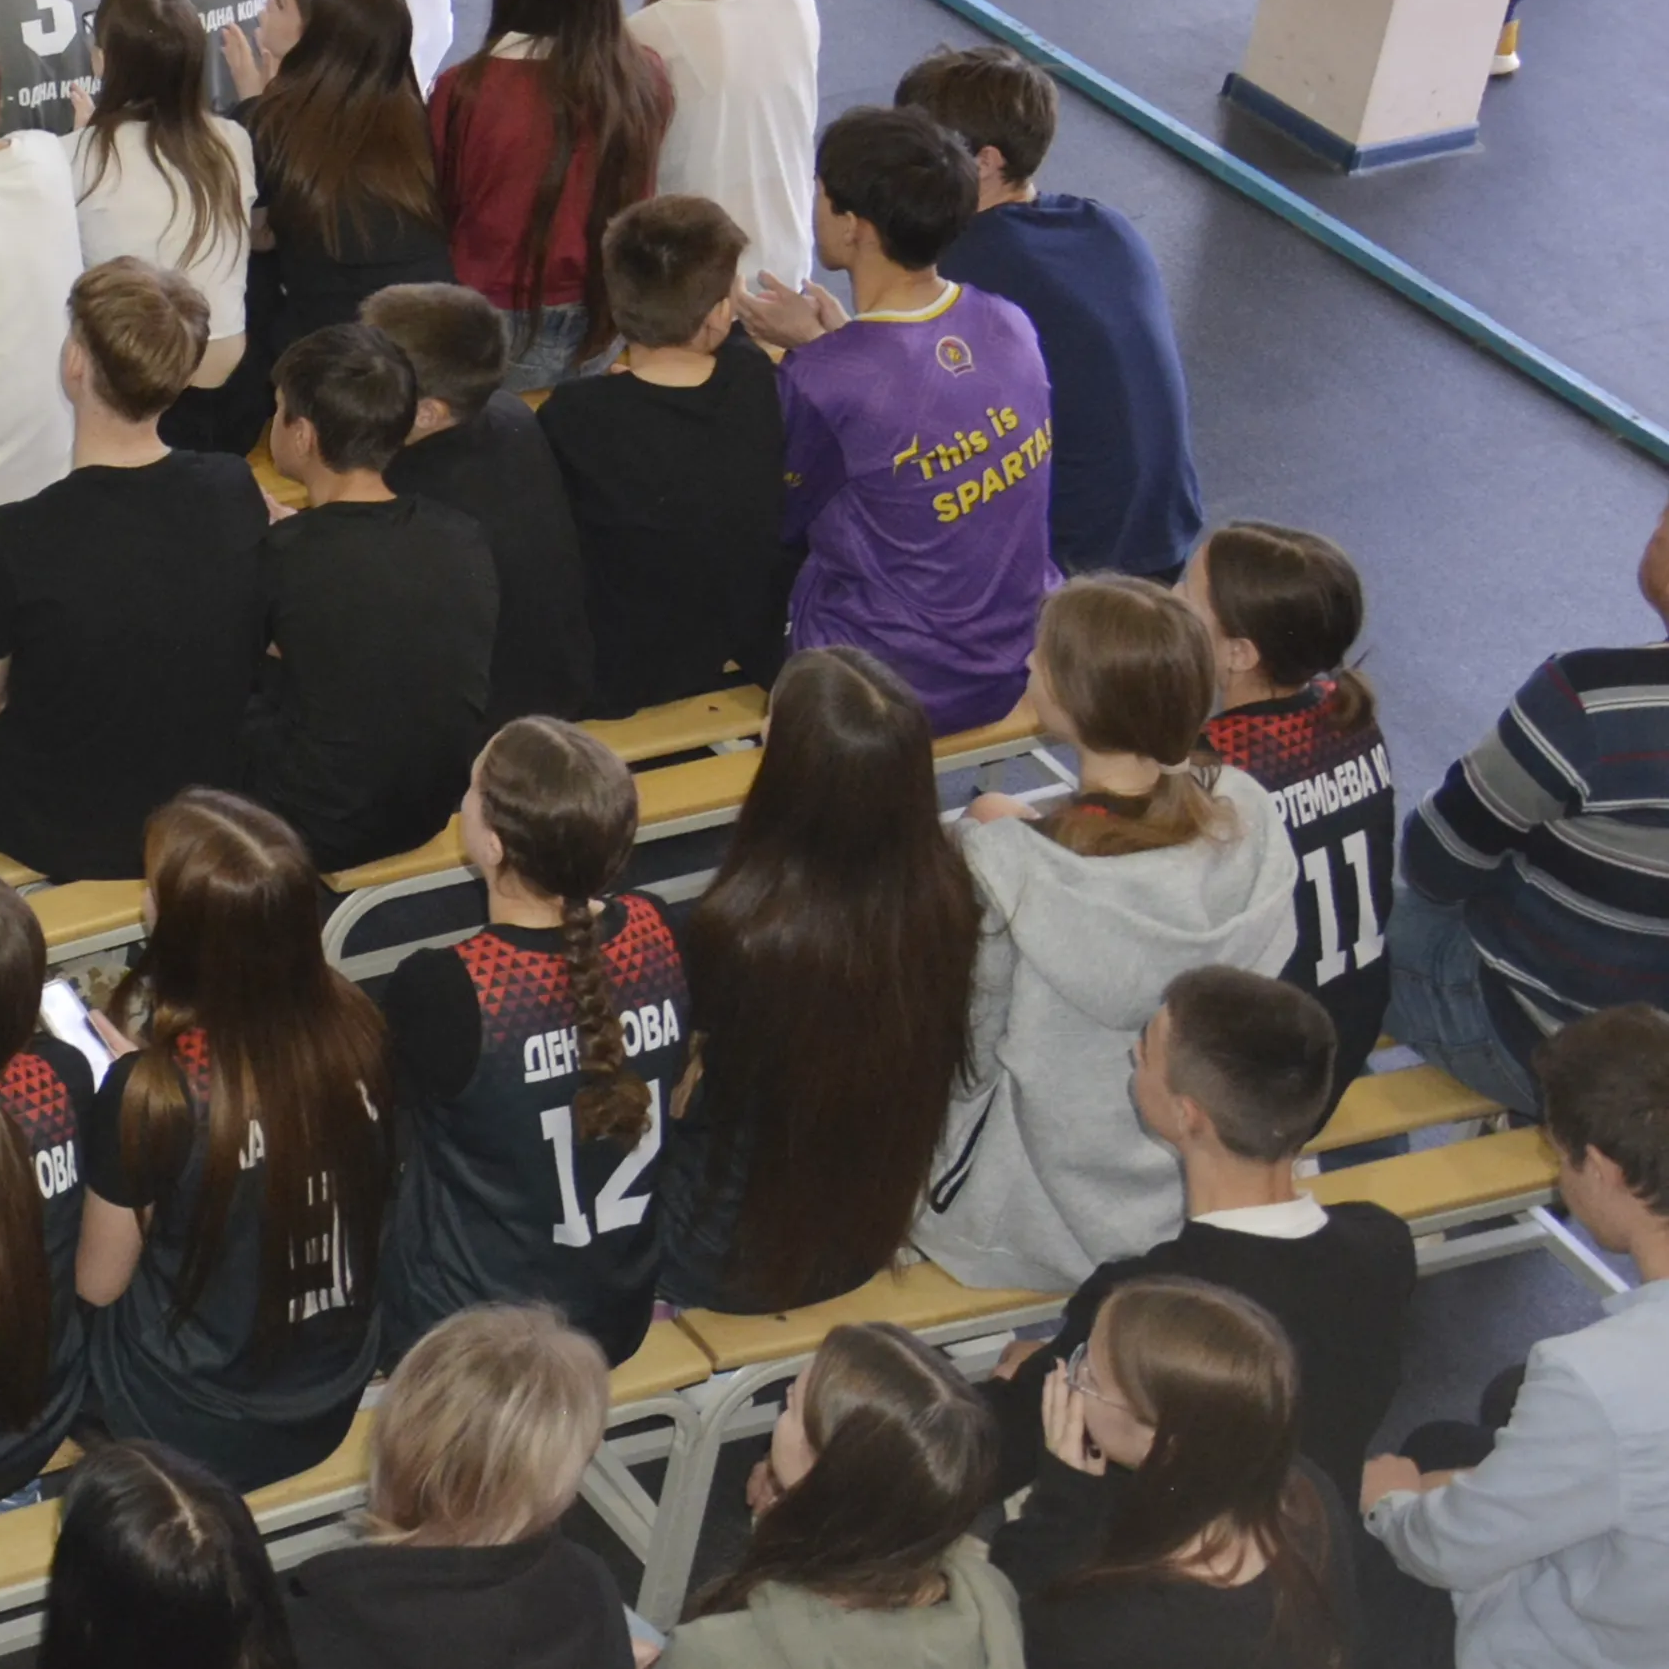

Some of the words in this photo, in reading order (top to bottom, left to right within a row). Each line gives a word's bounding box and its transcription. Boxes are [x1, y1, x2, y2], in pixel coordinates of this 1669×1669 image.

[912, 430, 989, 481] This
[985, 406, 1019, 438] is
[932, 417, 1053, 523] SPARTA!
[1268, 753, 1378, 829] РТЕМЬЕВА
[1302, 830, 1385, 987] 11
[523, 998, 681, 1084] ДЕНОВА
[540, 1077, 662, 1248] 12
